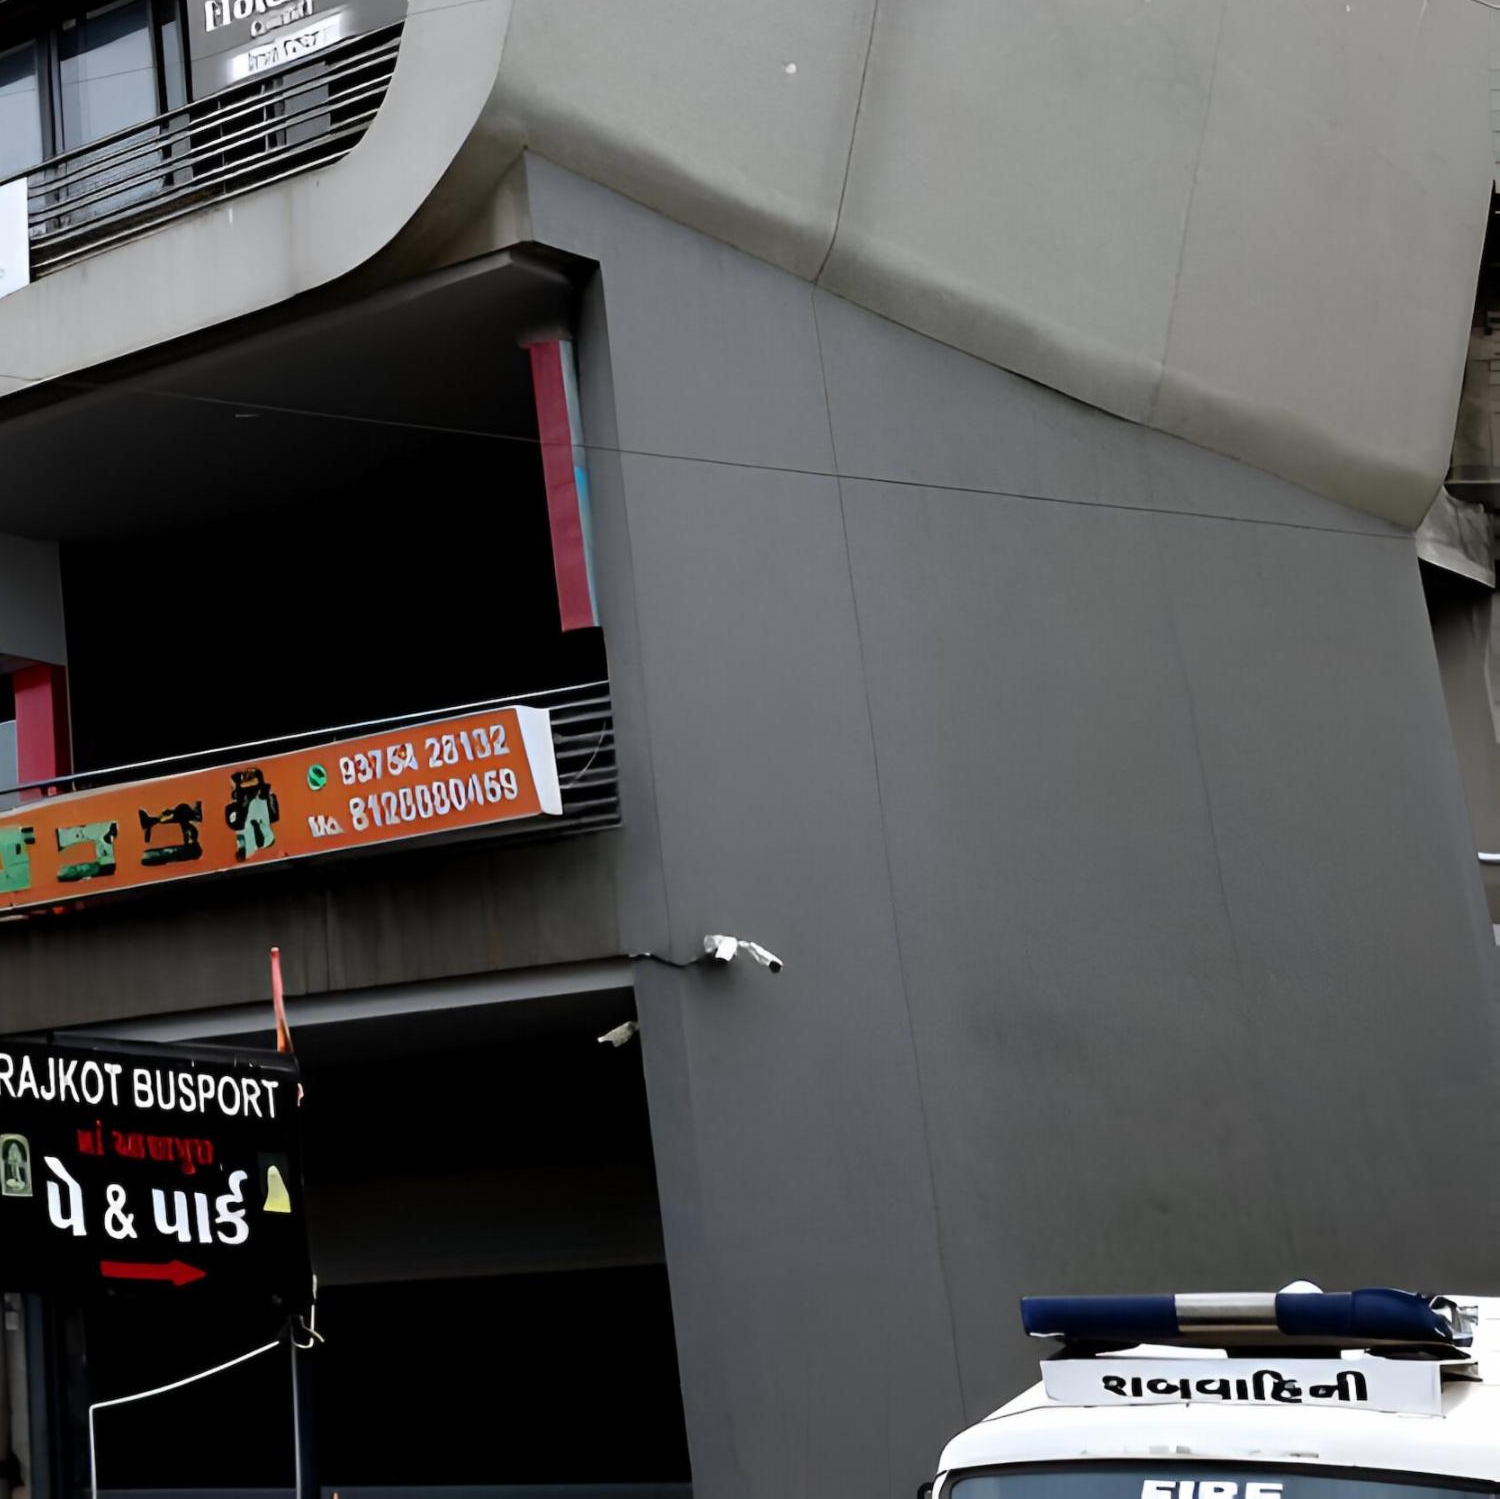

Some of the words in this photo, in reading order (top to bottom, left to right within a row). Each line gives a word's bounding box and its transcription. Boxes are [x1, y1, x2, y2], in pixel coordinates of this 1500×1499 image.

[132, 1068, 280, 1119] BUSPORT
[43, 1156, 88, 1236] પે
[103, 1183, 138, 1240] &
